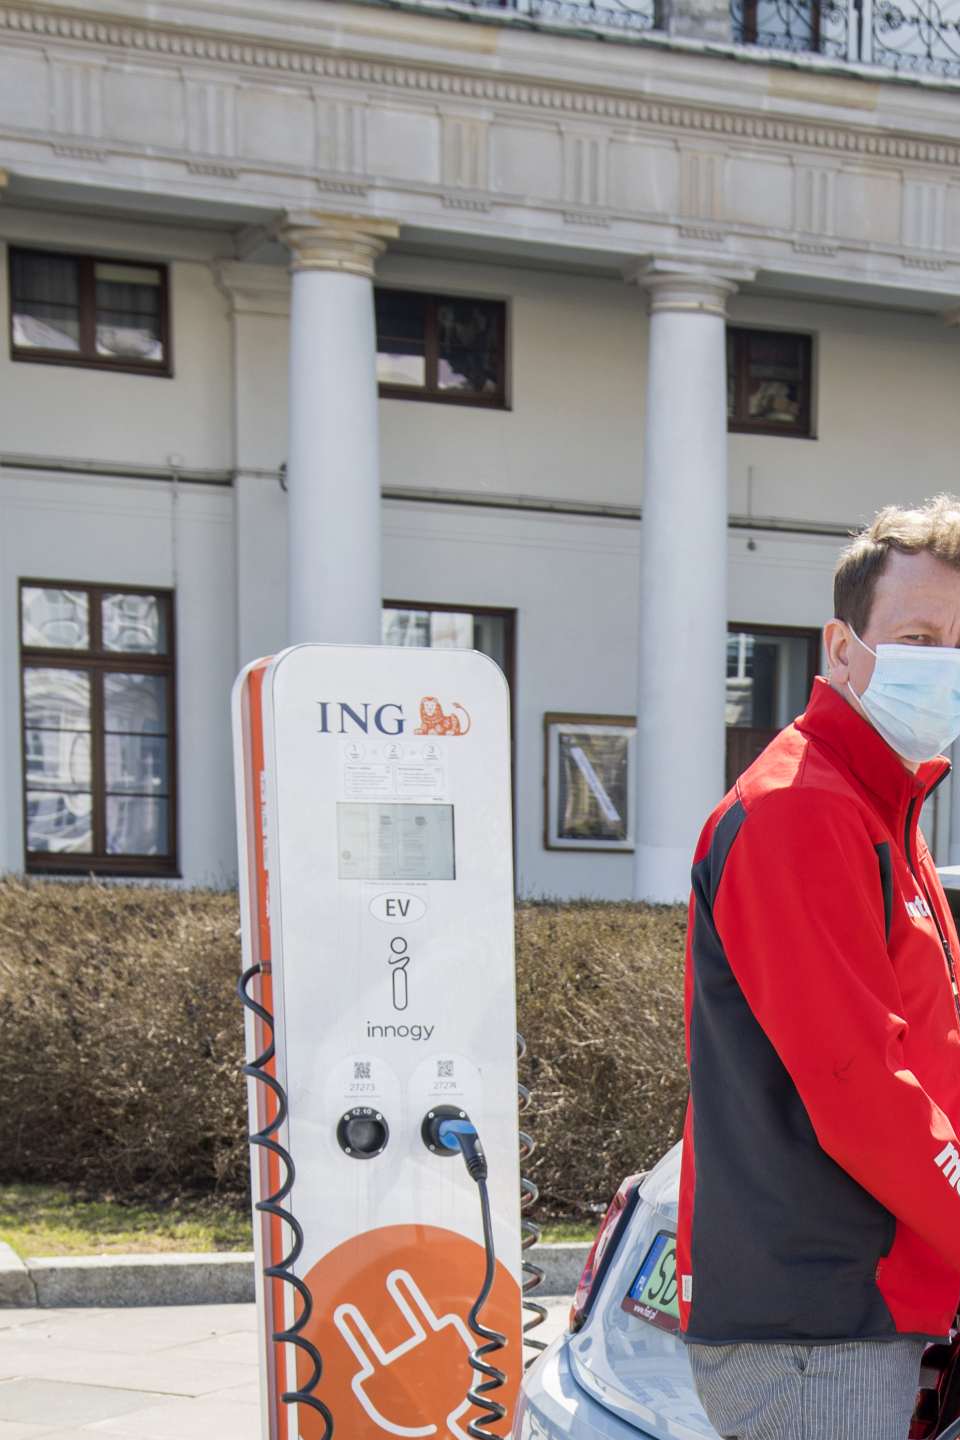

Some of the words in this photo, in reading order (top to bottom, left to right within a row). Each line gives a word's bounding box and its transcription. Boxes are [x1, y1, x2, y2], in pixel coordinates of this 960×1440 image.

[317, 701, 406, 735] ING
[385, 898, 411, 917] EV
[366, 1020, 435, 1041] innogy
